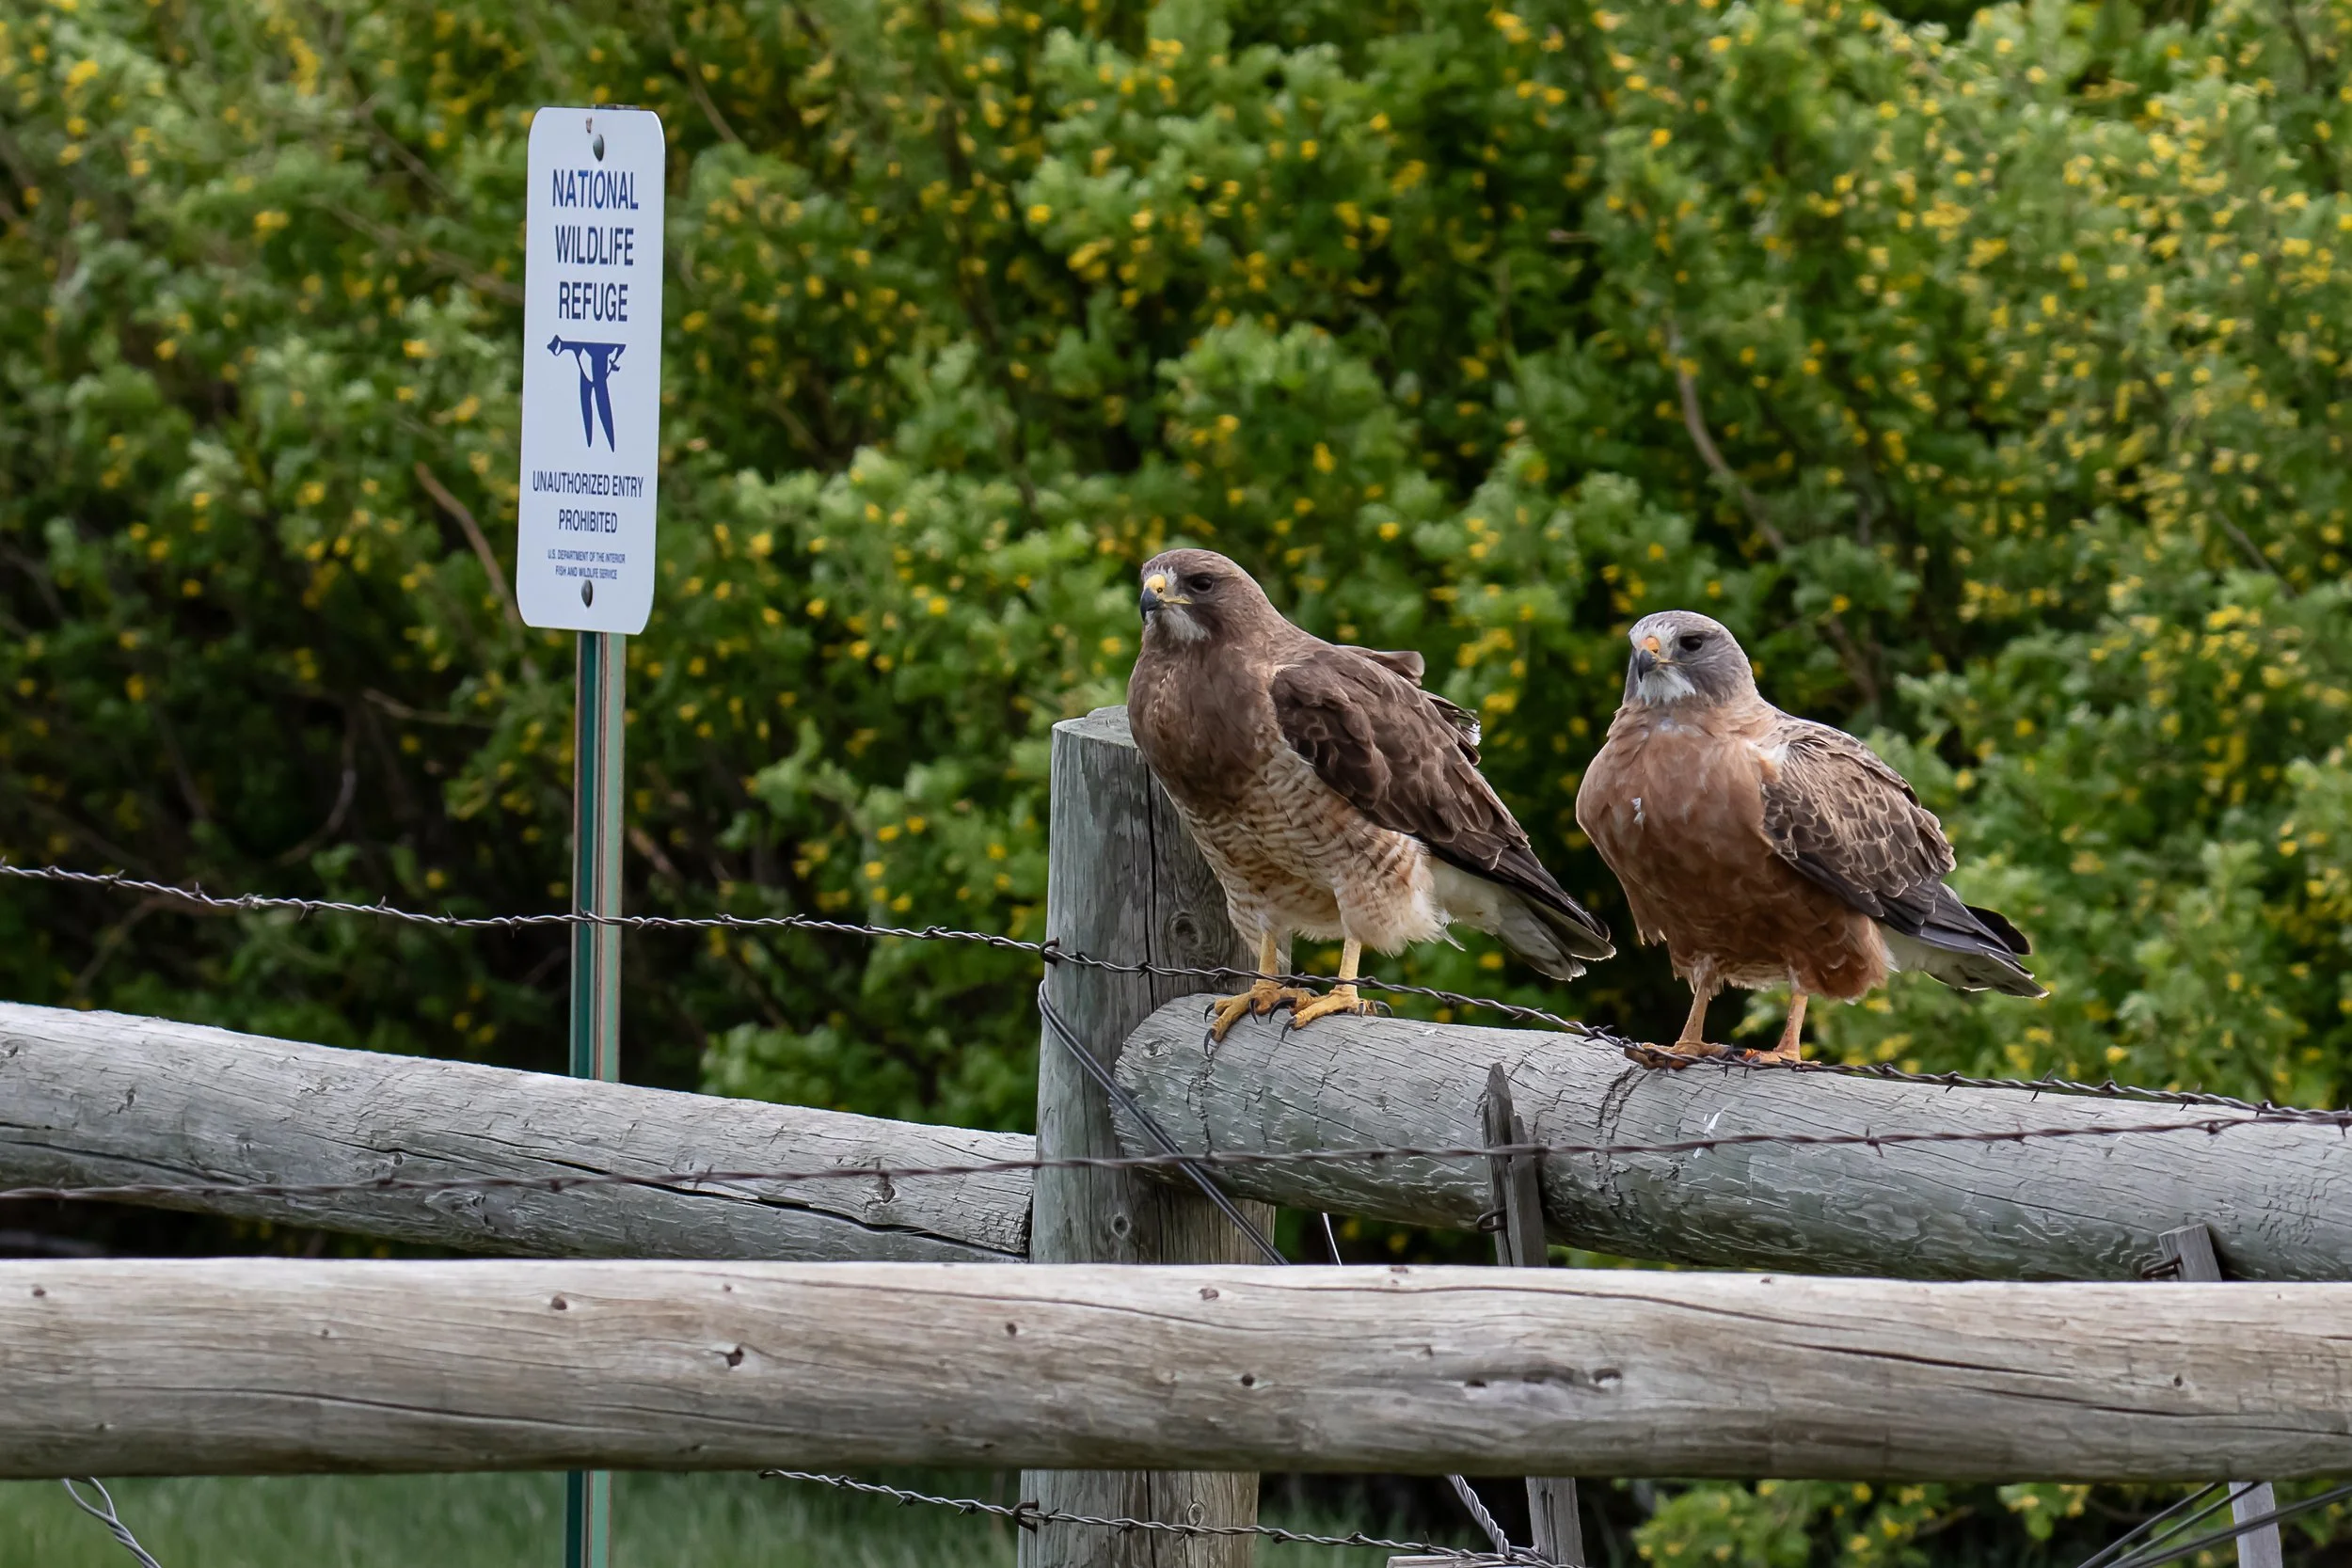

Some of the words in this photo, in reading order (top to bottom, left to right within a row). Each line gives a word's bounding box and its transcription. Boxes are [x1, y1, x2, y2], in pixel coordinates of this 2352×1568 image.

[552, 168, 639, 210] NATIONAL
[555, 225, 634, 266] WILDLIFE
[559, 281, 628, 322] REFUGE
[532, 470, 610, 496] UNAUTHORIZED
[612, 475, 644, 498] ENTRY
[558, 509, 618, 533] PROHIBITED
[548, 549, 557, 560] U.S.
[558, 549, 588, 562] DEPARTMENT
[589, 551, 596, 562] OF
[596, 552, 605, 562] THE
[605, 553, 626, 564] INTERIOR
[555, 565, 566, 577] FISH
[567, 566, 578, 577] AND
[579, 567, 598, 578] WILDLIFE
[599, 569, 617, 579] SERVICE
